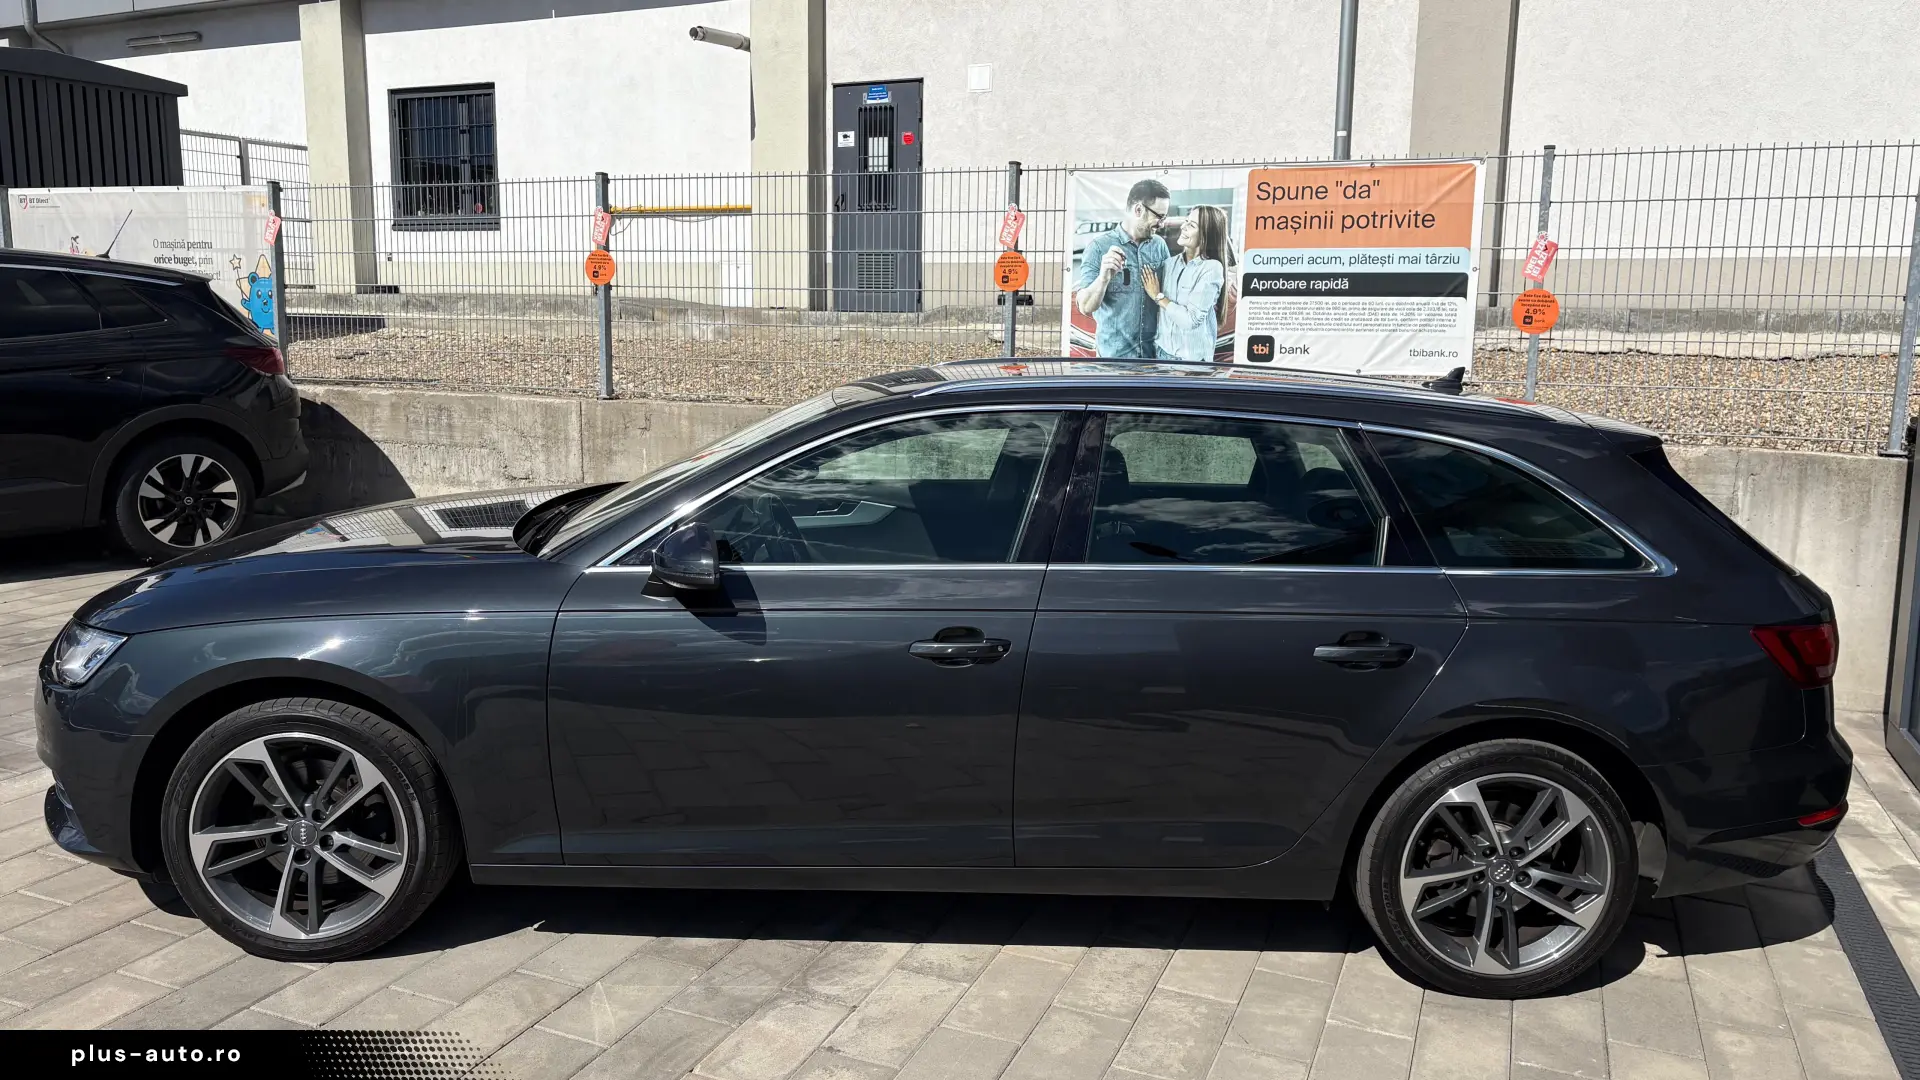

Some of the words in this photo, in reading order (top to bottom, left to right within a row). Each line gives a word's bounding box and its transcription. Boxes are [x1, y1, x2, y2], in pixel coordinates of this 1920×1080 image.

[1256, 182, 1328, 204] Spune
[1335, 180, 1381, 200] "da"
[1255, 211, 1334, 235] mașinii
[1341, 210, 1436, 233] potrivite
[152, 239, 159, 248] O
[160, 239, 186, 251] mașină
[187, 240, 213, 251] pentru
[154, 254, 172, 264] orice
[173, 255, 197, 266] buget,
[198, 256, 214, 268] prin
[1252, 254, 1304, 268] Cumperi
[1307, 255, 1345, 266] acum,
[1349, 254, 1394, 267] plătești
[1398, 254, 1422, 265] mai
[1425, 253, 1460, 265] târziu
[1524, 256, 1539, 275] VREI
[1250, 278, 1306, 292] Aprobare
[1310, 278, 1349, 291] rapidă
[1252, 343, 1269, 354] tbi
[1280, 344, 1310, 354] bank
[1409, 349, 1458, 358] tbibank.ro
